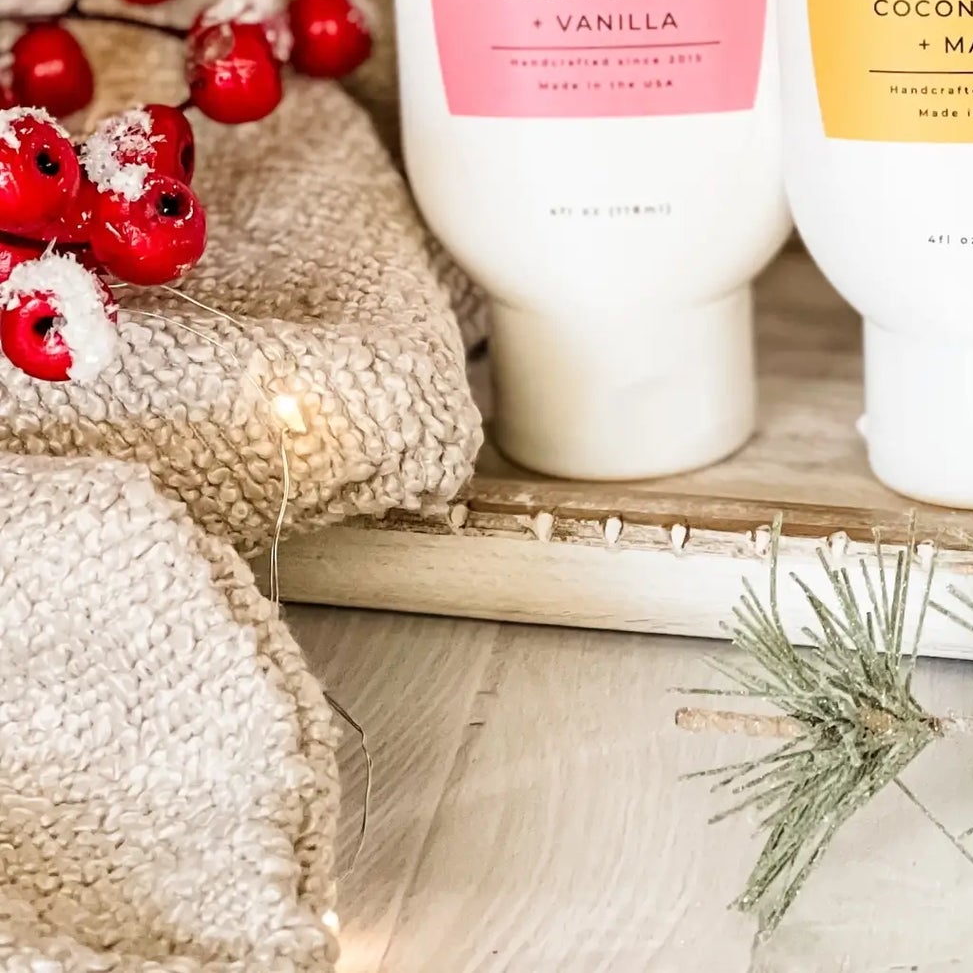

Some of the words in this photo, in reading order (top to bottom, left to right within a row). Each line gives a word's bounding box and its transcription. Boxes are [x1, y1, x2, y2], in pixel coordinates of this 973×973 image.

[557, 12, 678, 32] VANILLA
[919, 39, 930, 50] +
[919, 108, 958, 118] Made
[928, 235, 950, 244] 4fl
